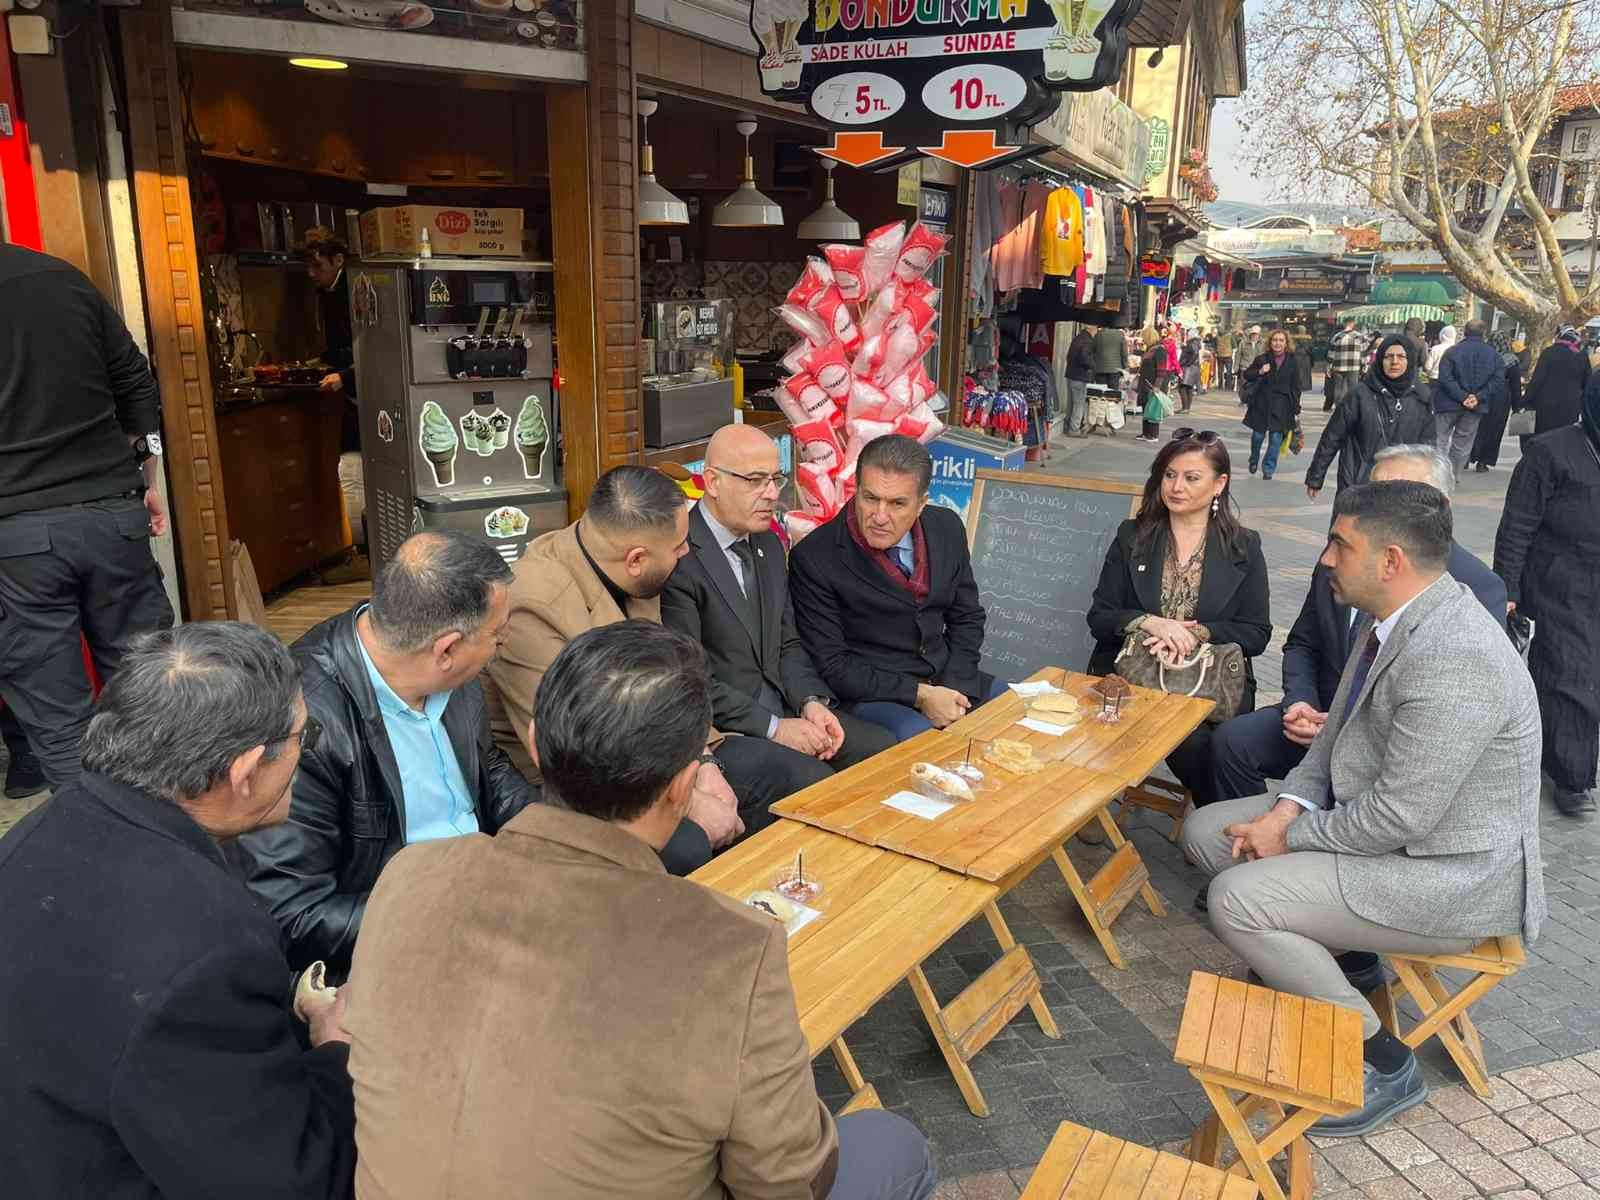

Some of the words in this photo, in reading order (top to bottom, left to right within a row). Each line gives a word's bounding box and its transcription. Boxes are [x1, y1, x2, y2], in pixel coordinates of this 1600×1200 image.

[811, 44, 849, 62] SADE
[943, 31, 1016, 54] SUNDAE
[929, 454, 976, 479] rikli
